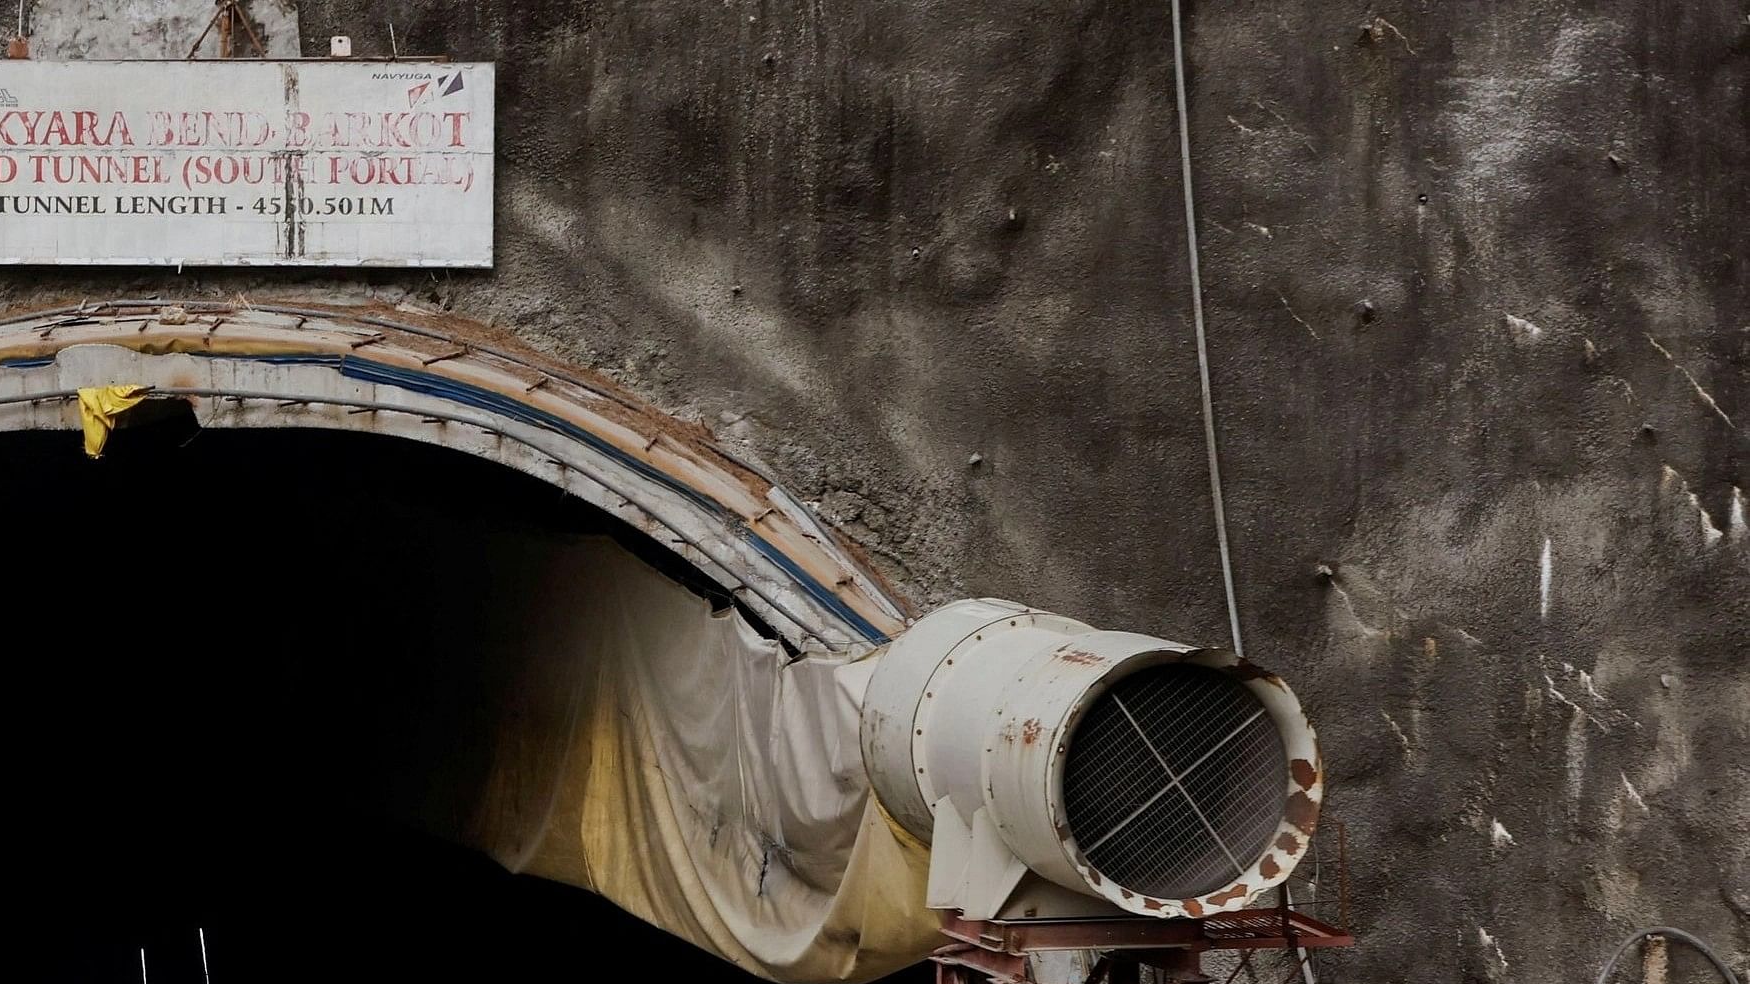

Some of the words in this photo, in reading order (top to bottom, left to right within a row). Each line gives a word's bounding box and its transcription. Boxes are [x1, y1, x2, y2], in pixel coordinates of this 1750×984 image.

[28, 154, 171, 184] TUNNEL
[328, 155, 475, 193] PORTAL)
[114, 195, 226, 215] LENGTH
